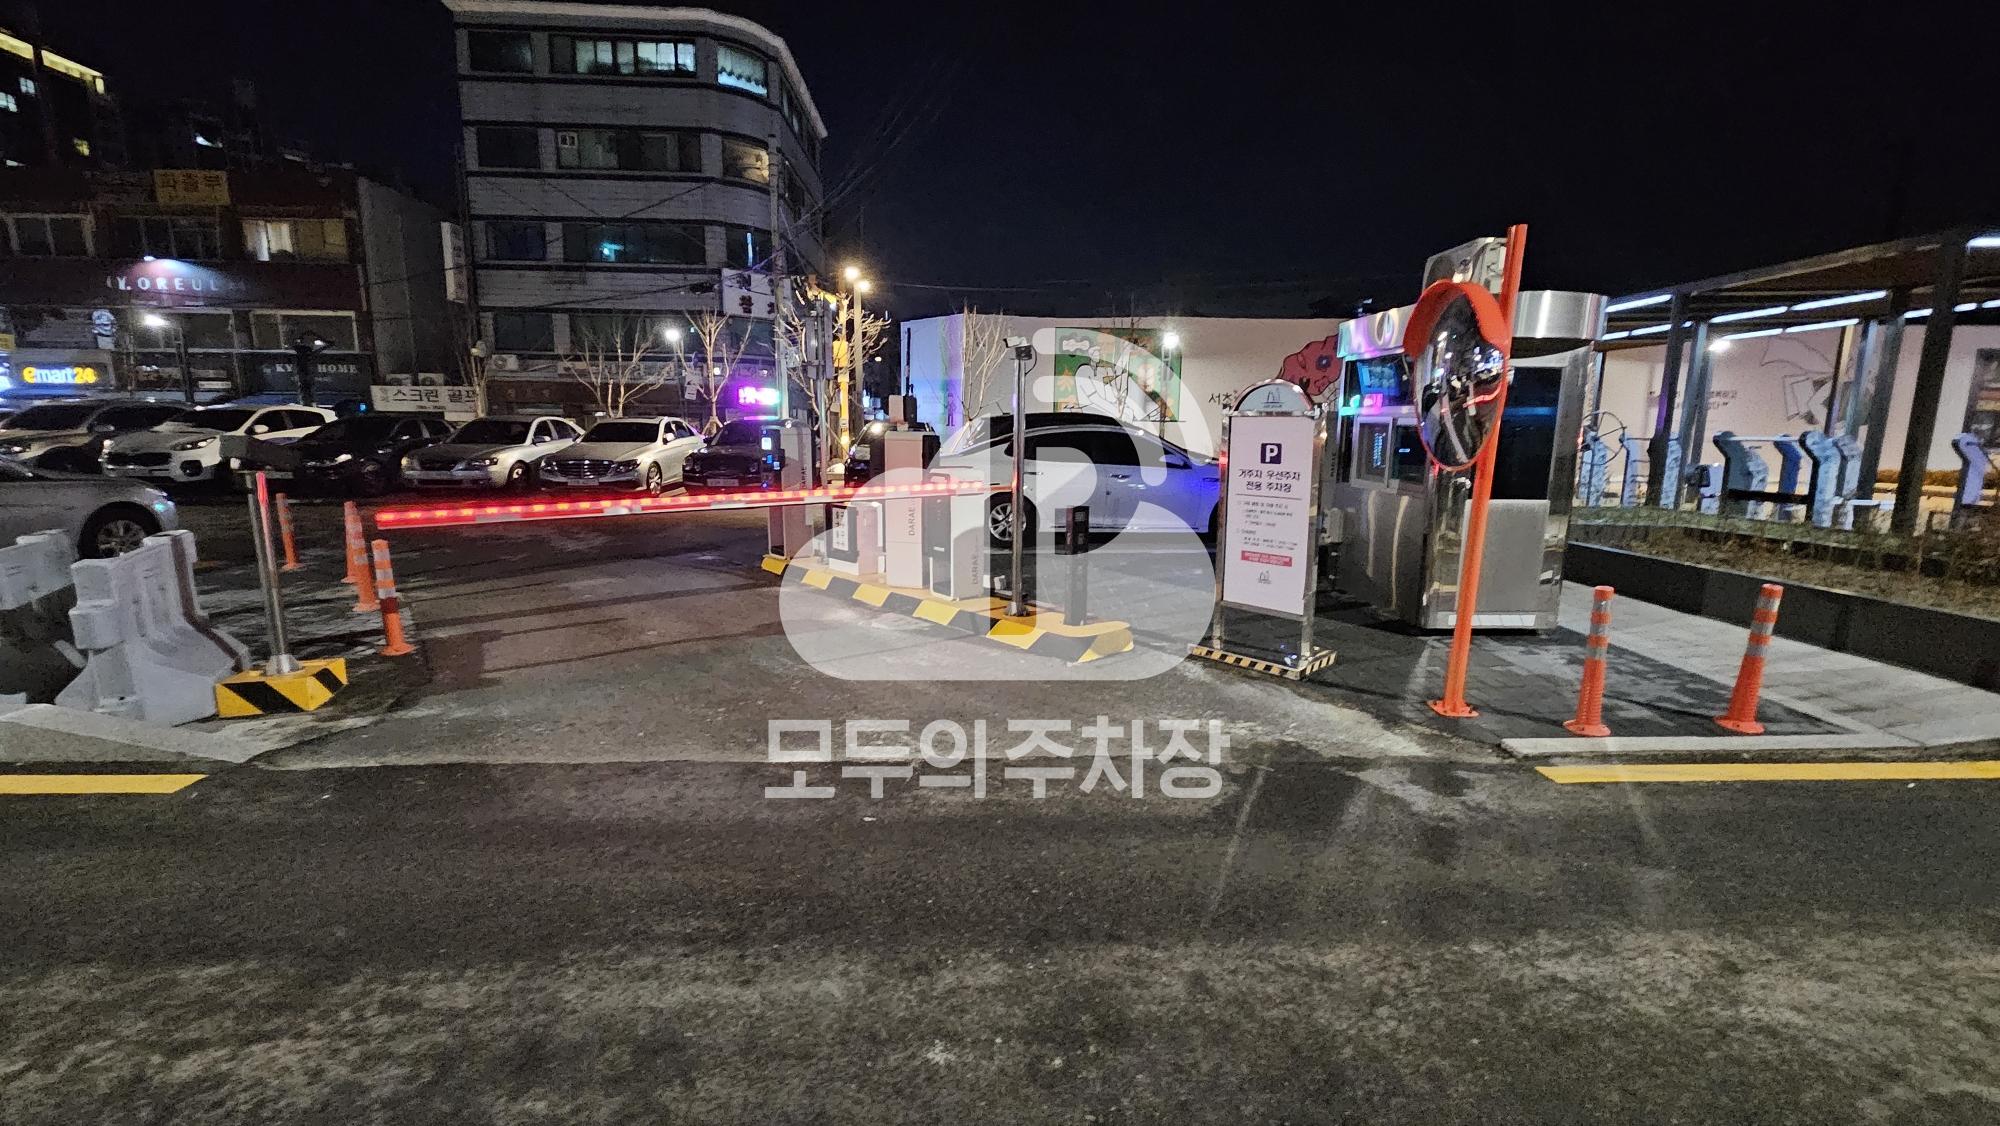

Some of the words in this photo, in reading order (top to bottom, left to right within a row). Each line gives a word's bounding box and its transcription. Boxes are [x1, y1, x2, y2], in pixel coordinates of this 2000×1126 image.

[22, 366, 97, 384] emart24
[392, 388, 439, 403] 스크린
[1265, 444, 1279, 463] P
